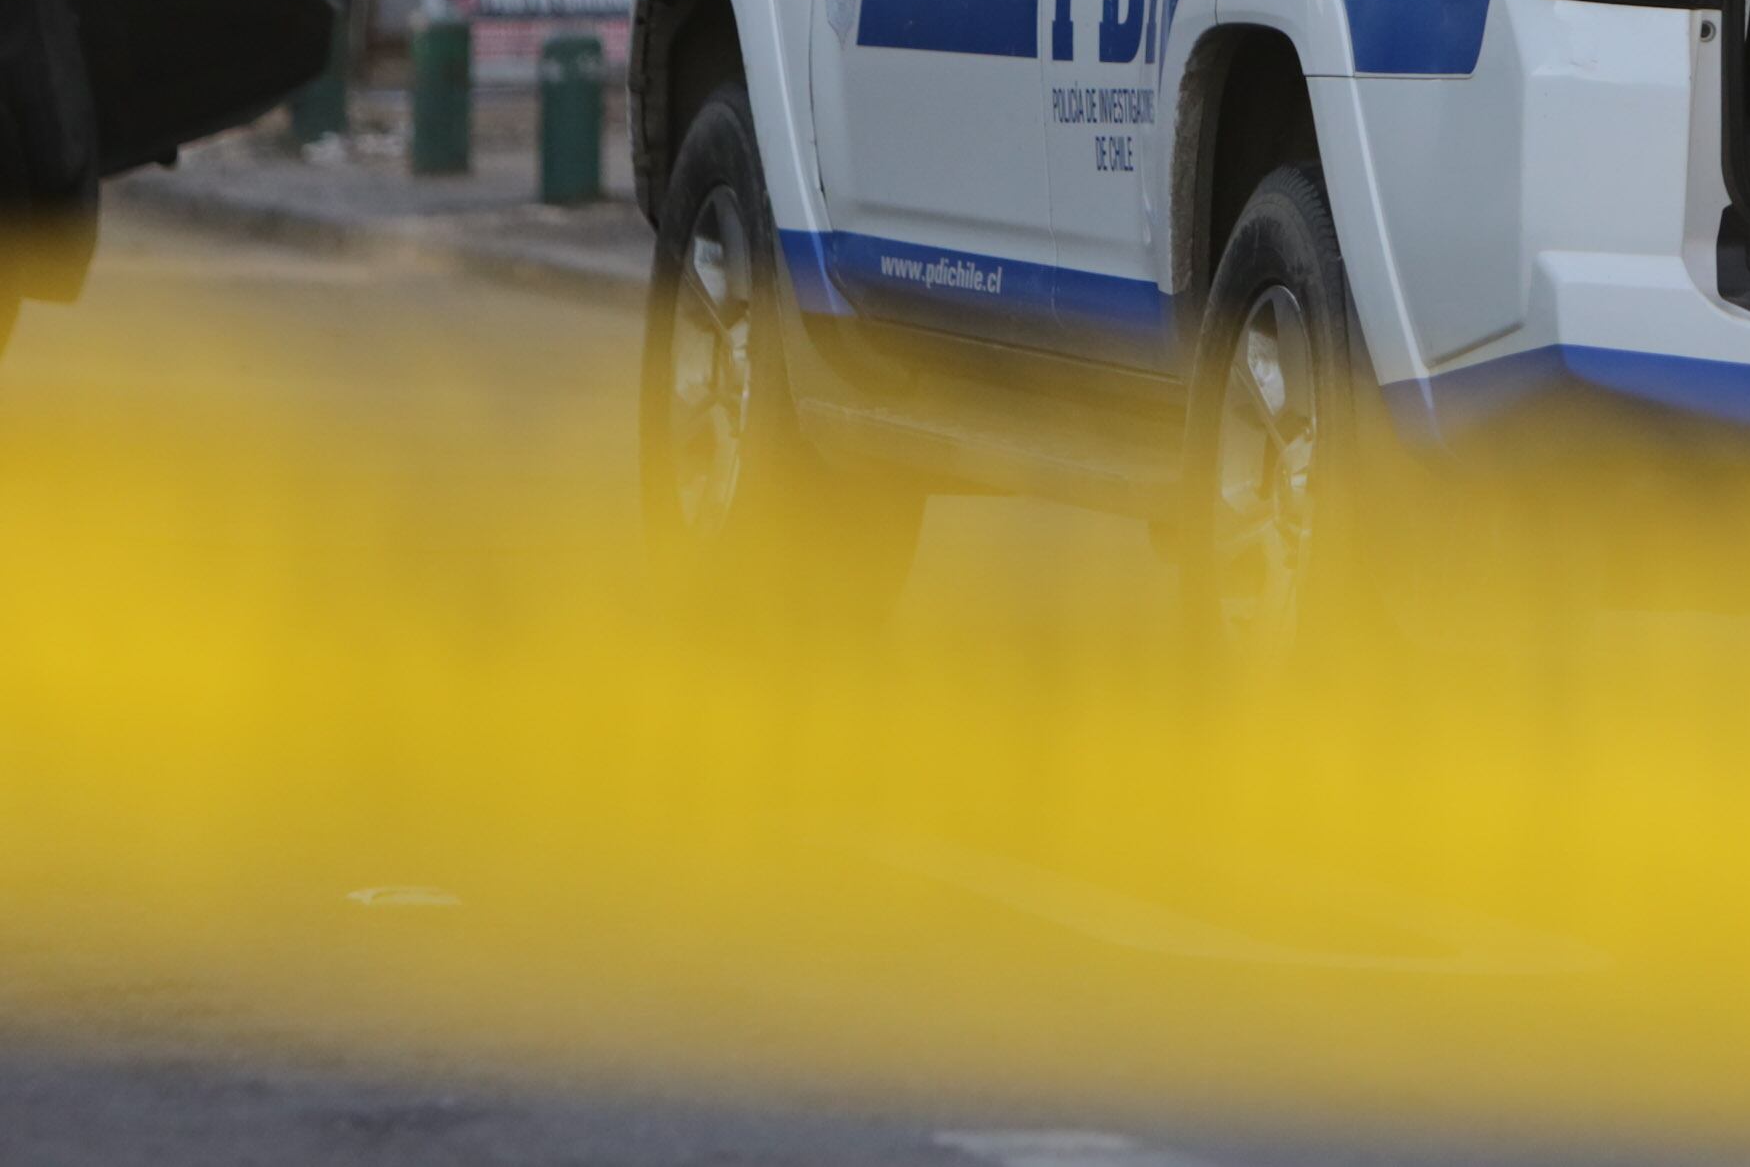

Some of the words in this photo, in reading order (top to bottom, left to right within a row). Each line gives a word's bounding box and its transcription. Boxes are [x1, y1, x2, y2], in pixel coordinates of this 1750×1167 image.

[1052, 81, 1085, 124] POLICÍA
[1085, 87, 1098, 124] DE
[1098, 87, 1155, 125] INVESTIGA
[1095, 135, 1107, 172] DE
[1108, 135, 1134, 172] CHILE
[881, 255, 1003, 294] www.pdichile.cl
